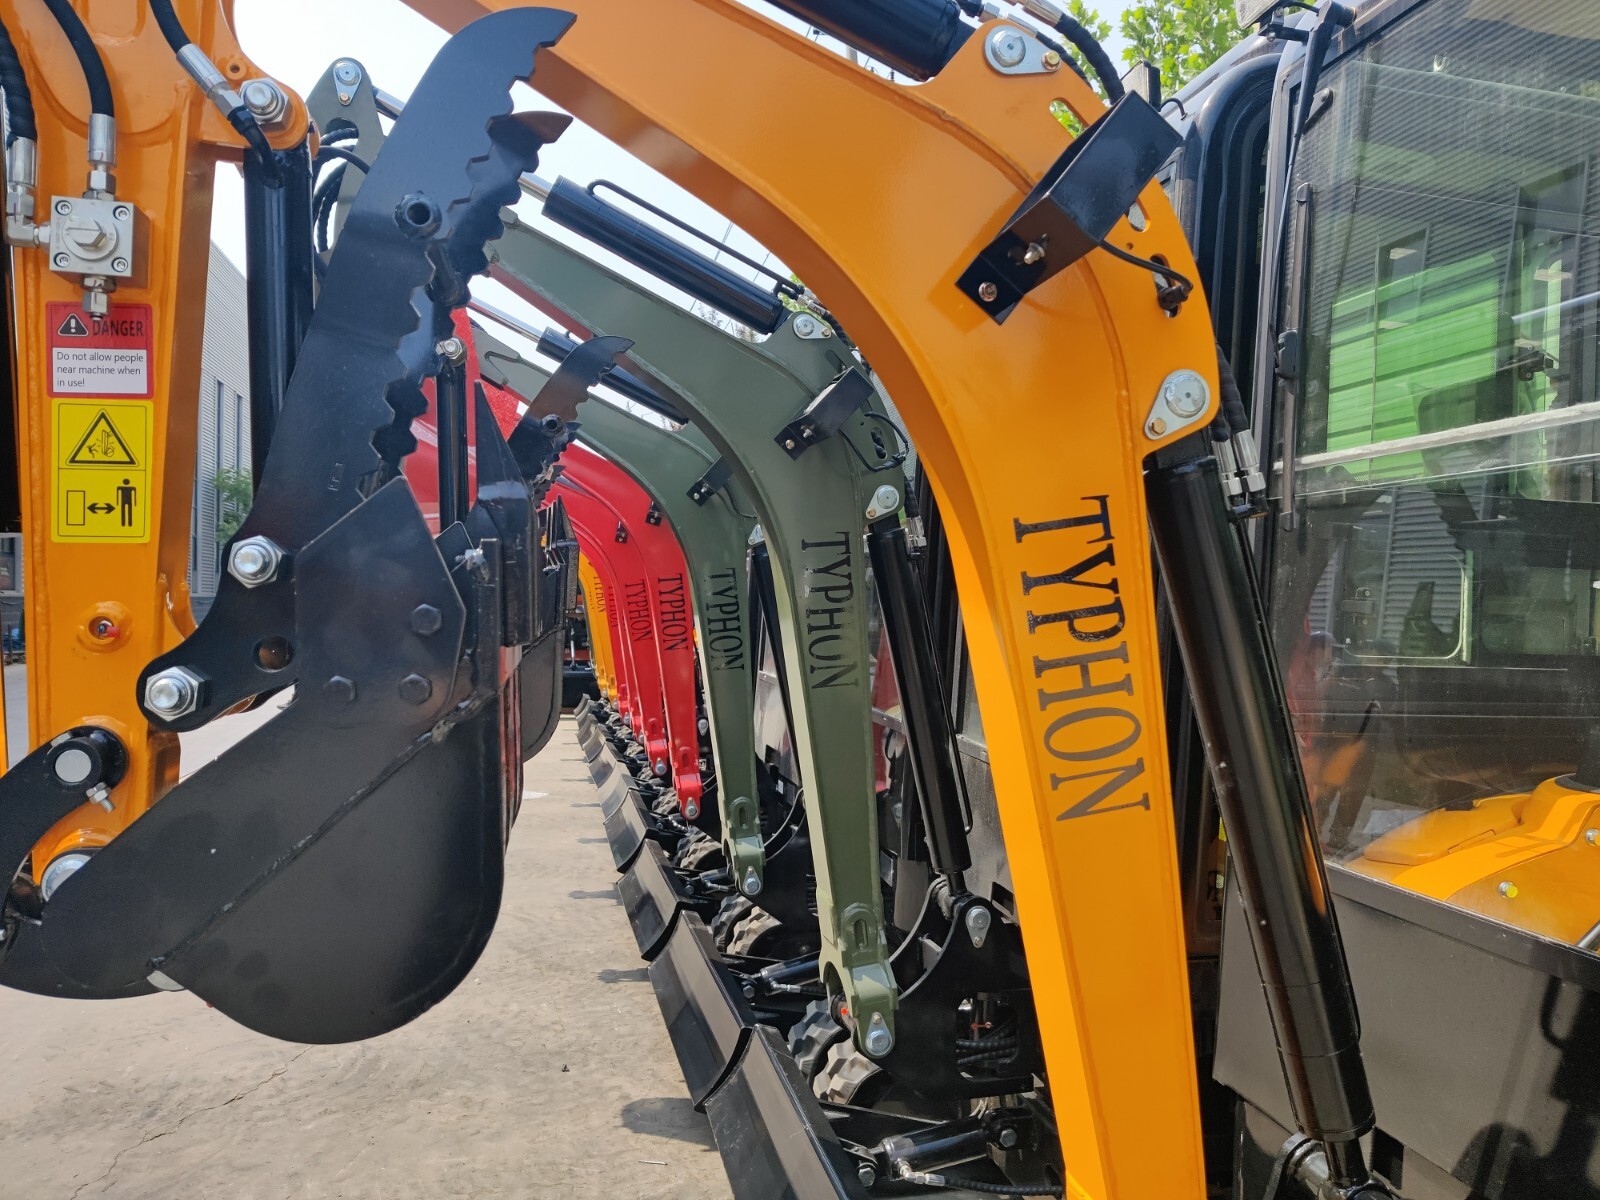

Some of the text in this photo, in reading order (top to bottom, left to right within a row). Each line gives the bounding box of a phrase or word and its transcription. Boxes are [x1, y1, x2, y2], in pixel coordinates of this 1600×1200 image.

[56, 351, 144, 364] Do not allow people
[92, 319, 144, 337] DANGER
[56, 365, 141, 375] near machine when
[57, 378, 85, 387] in use!
[624, 579, 654, 642] TYPHON
[657, 572, 689, 651] TYPHON
[704, 567, 745, 671] TYPHON
[801, 531, 860, 689] TYPHON
[1013, 494, 1151, 821] TYPHON
